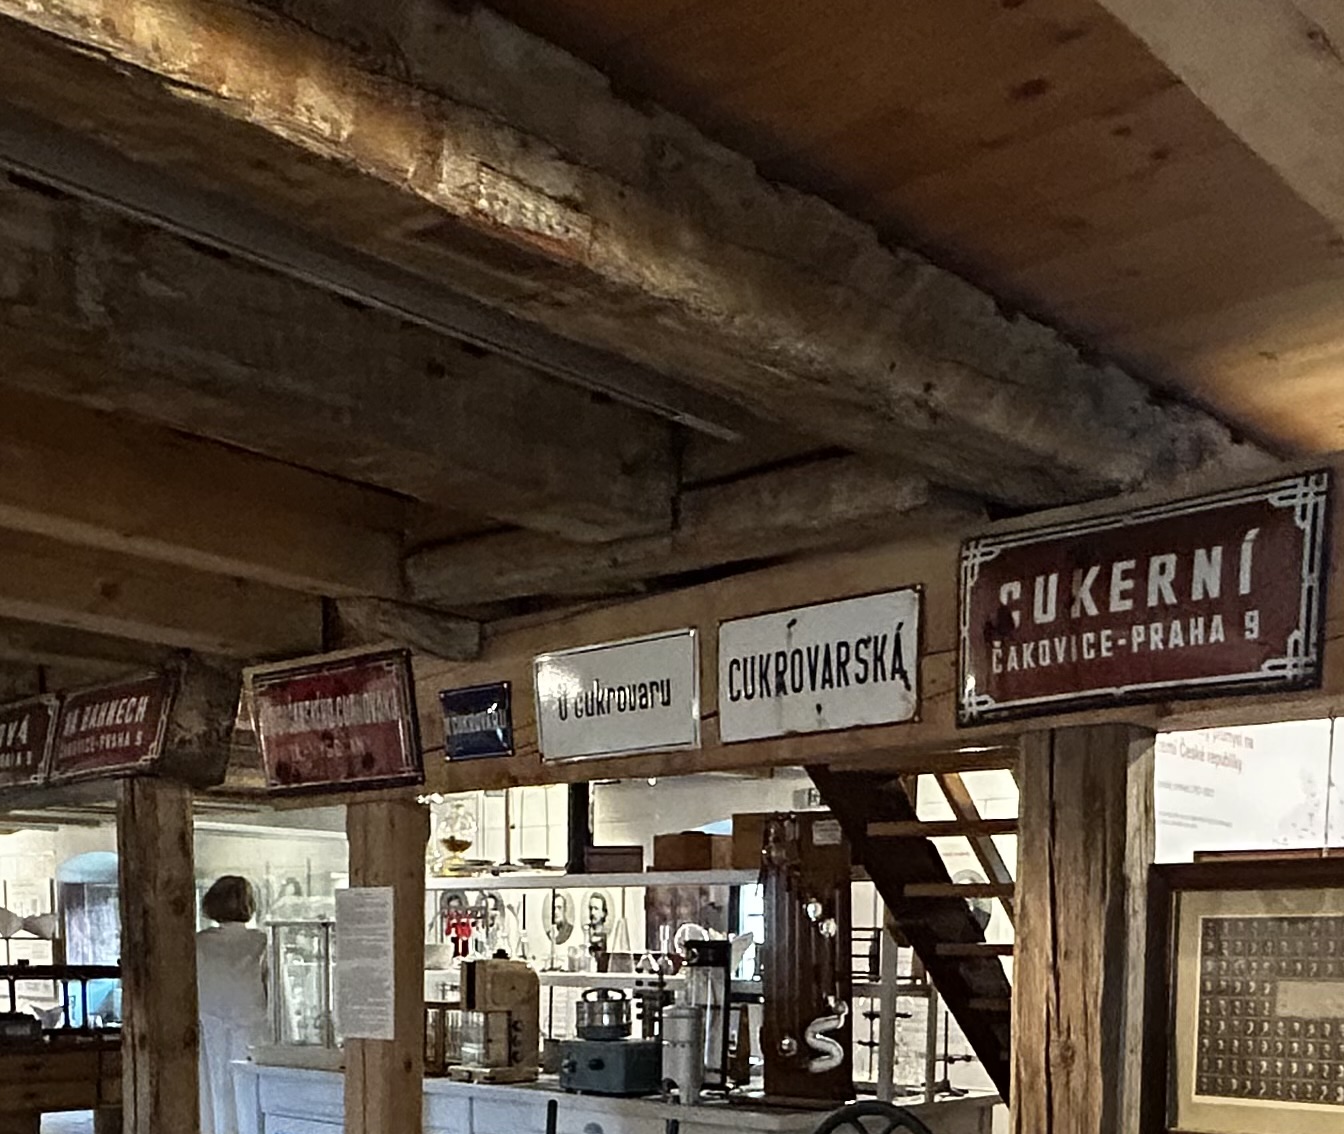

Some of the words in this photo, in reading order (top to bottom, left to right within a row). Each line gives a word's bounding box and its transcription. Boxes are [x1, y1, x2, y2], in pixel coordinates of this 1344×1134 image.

[728, 622, 907, 702] CUKROVARSKÁ
[991, 614, 1226, 675] ČAKOVICE-PRAHA
[1244, 609, 1260, 641] 9
[574, 678, 671, 719] cukrovaru
